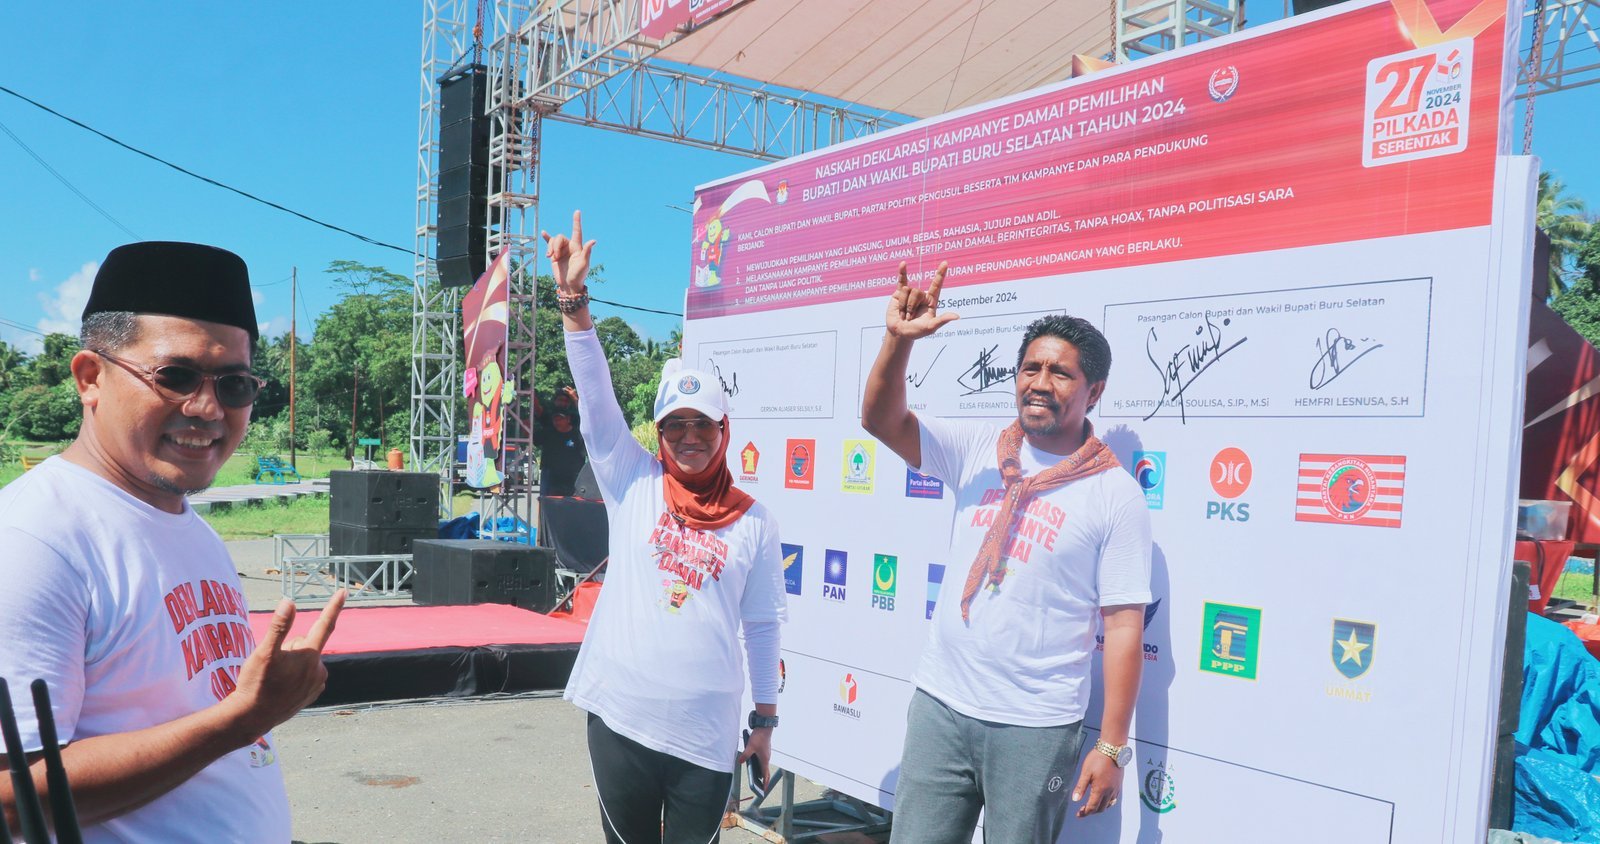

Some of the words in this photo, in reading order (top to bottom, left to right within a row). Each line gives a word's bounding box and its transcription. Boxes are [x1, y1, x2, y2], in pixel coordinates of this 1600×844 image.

[1374, 53, 1437, 120] 27
[1427, 83, 1462, 96] NOVEMBER
[1426, 91, 1461, 109] 2024
[815, 157, 860, 180] NASKAH
[863, 139, 931, 167] DEKLARASI
[934, 117, 1009, 150] KAMPANYE
[1013, 103, 1064, 130] DAMAI
[1069, 77, 1165, 117] PEMILIHAN
[1373, 108, 1459, 139] PILKADA
[802, 181, 840, 202] BUPATI
[843, 175, 868, 194] DAN
[870, 166, 909, 189] WAKIL
[912, 153, 959, 176] BUPATI
[962, 140, 1001, 165] BURU
[1006, 125, 1073, 155] SELATAN
[1078, 110, 1137, 137] TAHUN
[1142, 97, 1186, 123] 2024
[1378, 131, 1451, 155] SERENTAK
[754, 228, 773, 239] CALON
[775, 223, 796, 234] BUPATI
[797, 219, 811, 228] DAN
[812, 214, 833, 226] WAKIL
[834, 210, 860, 221] BUPATI,
[862, 203, 886, 215] PARTAI
[888, 196, 916, 209] POLITIK
[918, 185, 962, 203] PENGUSUL
[964, 178, 1001, 193] BESERTA
[1004, 174, 1020, 186] TIM
[1022, 162, 1075, 182] KAMPANYE
[1077, 157, 1100, 171] DAN
[1102, 150, 1131, 165] PARA
[1134, 134, 1208, 159] PENDUKUNG
[746, 268, 793, 284] MELAKSANAKAN
[794, 262, 829, 278] KAMPANYE
[830, 255, 867, 269] PEMILIHAN
[868, 251, 888, 263] YANG
[889, 247, 914, 261] AMAN,
[916, 242, 943, 255] TERTIP
[944, 239, 963, 251] DAN
[964, 235, 995, 248] DAMAI,
[997, 221, 1072, 243] BERINTEGRITAS,
[1074, 214, 1108, 230] TANPA
[1111, 210, 1144, 226] HOAX,
[1147, 204, 1186, 220] TANPA
[1188, 192, 1255, 213] POLITISASI
[1258, 186, 1295, 204] SARA
[746, 256, 789, 272] MEWUJUDKAN
[789, 251, 823, 265] PEMILIHAN
[824, 247, 843, 259] YANG
[844, 240, 884, 256] LANGSUNG,
[886, 235, 911, 248] UMUM,
[913, 230, 942, 244] BEBAS,
[943, 223, 981, 237] RAHASIA,
[983, 217, 1011, 231] JUJUR
[1014, 213, 1034, 226] DAN
[1036, 208, 1061, 223] ADIL.
[744, 293, 792, 306] MELAKSANAKAN
[792, 286, 828, 299] KAMPANYE
[829, 281, 866, 294] PEMILIHAN
[924, 264, 973, 280] PERTURAN
[976, 248, 1093, 273] PERUNDANG-UNDANGAN
[1096, 244, 1125, 257] YANG
[1127, 236, 1183, 254] BERLAKU.
[745, 284, 757, 294] DAN
[758, 280, 778, 292] TANPA
[778, 277, 797, 289] UANG
[948, 294, 993, 310] September
[996, 292, 1018, 303] 2024
[1138, 312, 1177, 324] Pasangan
[1179, 310, 1203, 321] Calon
[1205, 308, 1235, 319] Bupati
[1236, 306, 1255, 316] dan
[1256, 304, 1282, 315] Wakil
[1284, 301, 1317, 314] Bupati
[1319, 299, 1344, 310] Buru
[1346, 297, 1385, 308] Selatan
[957, 328, 973, 336] Wakil
[975, 326, 995, 335] Bupati
[996, 325, 1011, 333] Buru
[959, 402, 976, 410] ELISA
[977, 401, 1009, 410] FERIANTO
[1126, 400, 1155, 408] SAFITRI
[1157, 400, 1183, 408] MALIK
[1185, 399, 1226, 409] SOULISA,
[1250, 398, 1269, 407] M.Si
[1295, 398, 1333, 407] HEMFRI
[1336, 397, 1388, 407] LESNUSA,
[1391, 396, 1409, 406] S.H
[1206, 501, 1250, 522] PKS
[658, 552, 703, 590] DAMAI
[823, 585, 846, 600] PAN
[872, 595, 895, 611] PBB
[181, 622, 256, 681] KAMPANY
[1211, 660, 1245, 673] PPP
[1326, 686, 1371, 702] UMMAT
[833, 704, 861, 718] BAWASLU
